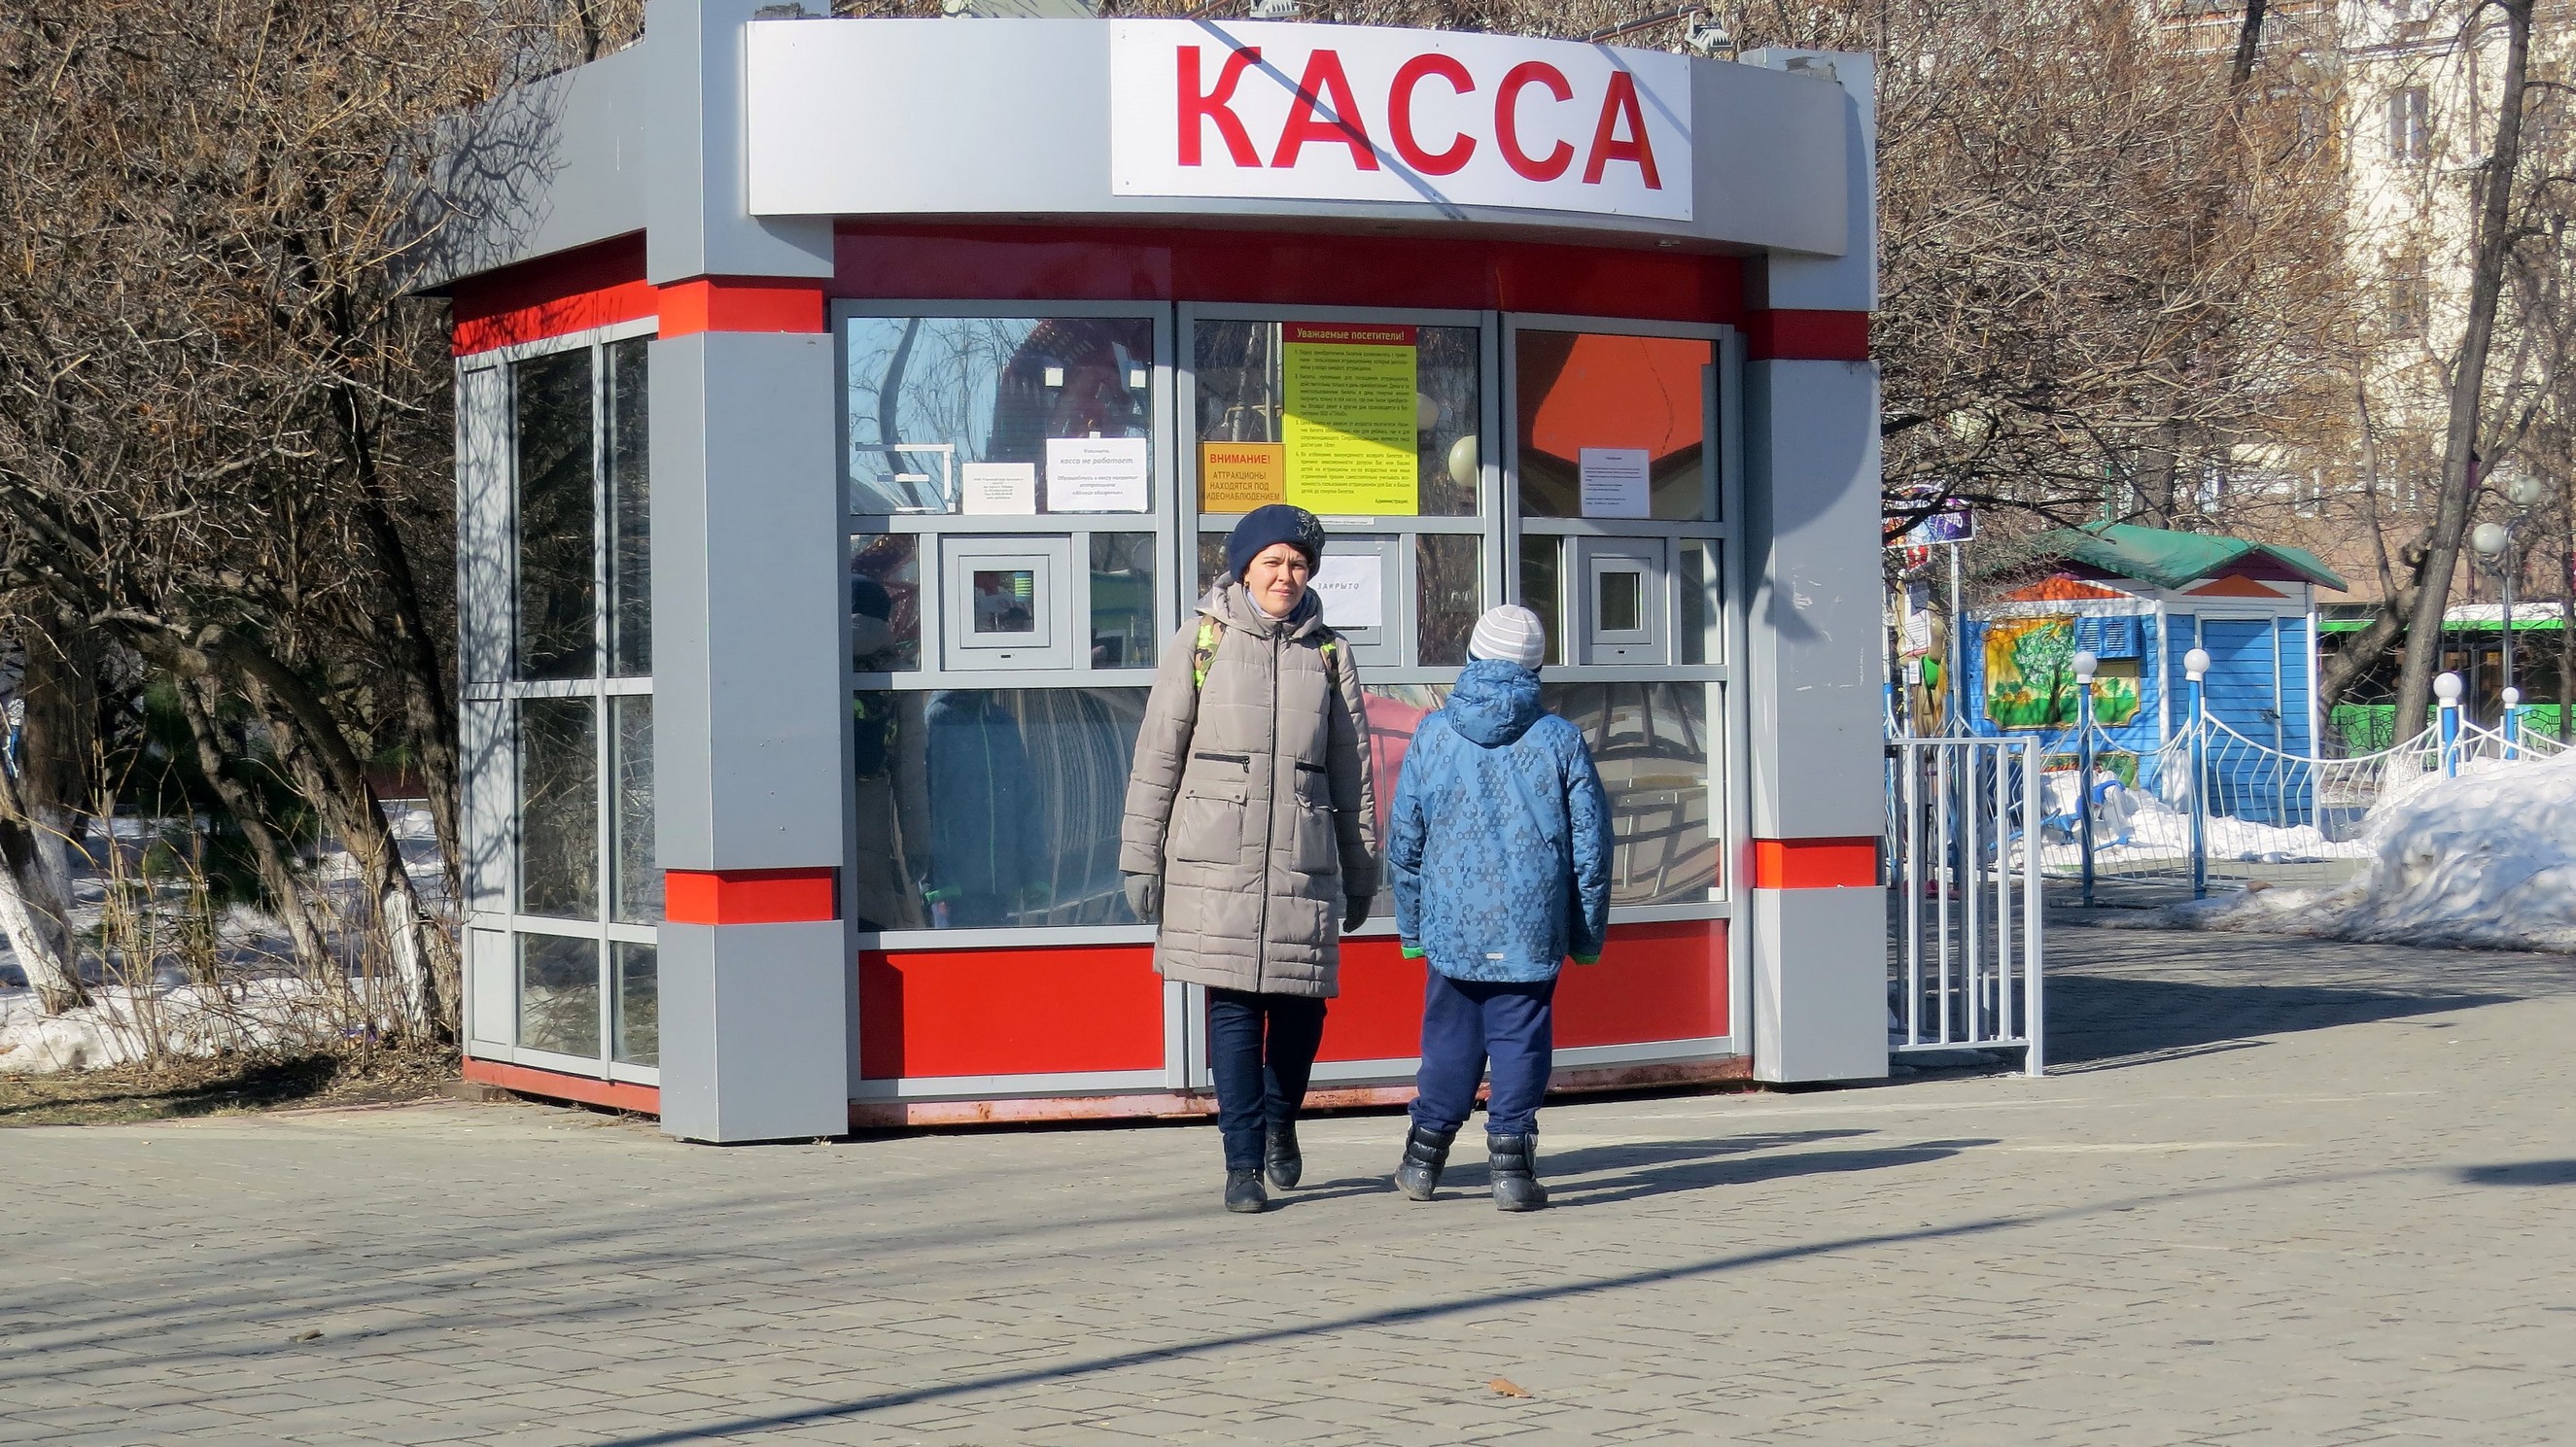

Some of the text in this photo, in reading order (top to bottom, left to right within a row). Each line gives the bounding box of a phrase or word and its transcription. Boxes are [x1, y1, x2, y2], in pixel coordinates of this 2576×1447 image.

[1176, 45, 1662, 190] КАССА
[1297, 327, 1405, 341] Уважаемые посетители!
[1209, 453, 1271, 465] ВНИМАНИЕ!
[1212, 470, 1267, 480] АТТРАКЦИОНЫ
[1209, 482, 1270, 492] НАХОДЯТСЯ ПОД
